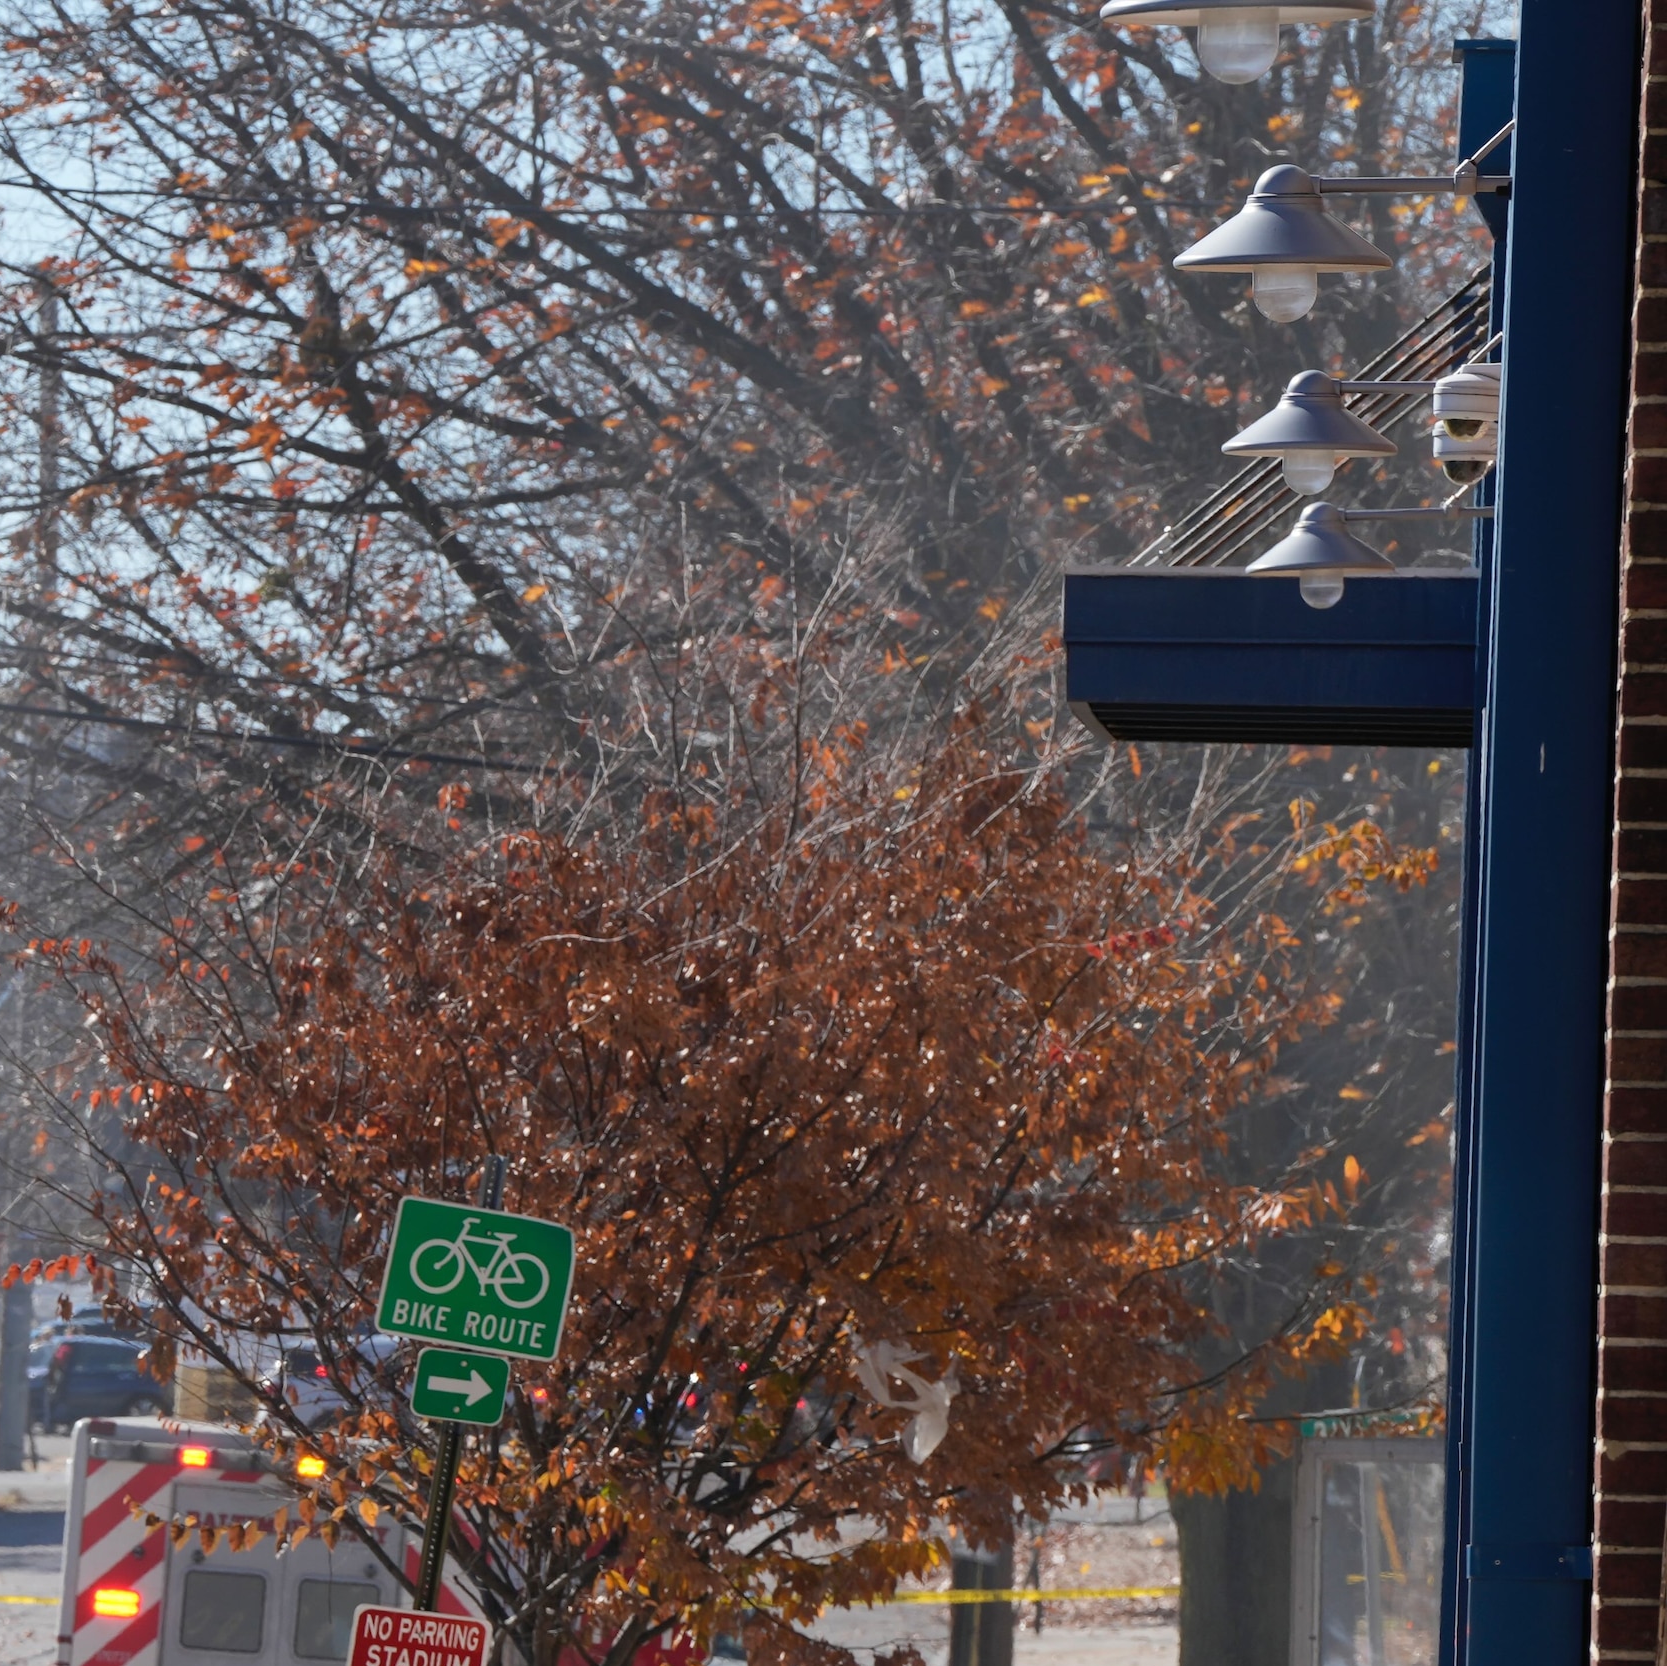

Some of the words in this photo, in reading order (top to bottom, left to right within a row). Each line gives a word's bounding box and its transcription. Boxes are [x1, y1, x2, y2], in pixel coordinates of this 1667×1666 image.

[392, 1299, 451, 1332] BIKE
[463, 1311, 546, 1349] ROUTE
[364, 1613, 393, 1641] NO
[398, 1617, 480, 1652] PARKING
